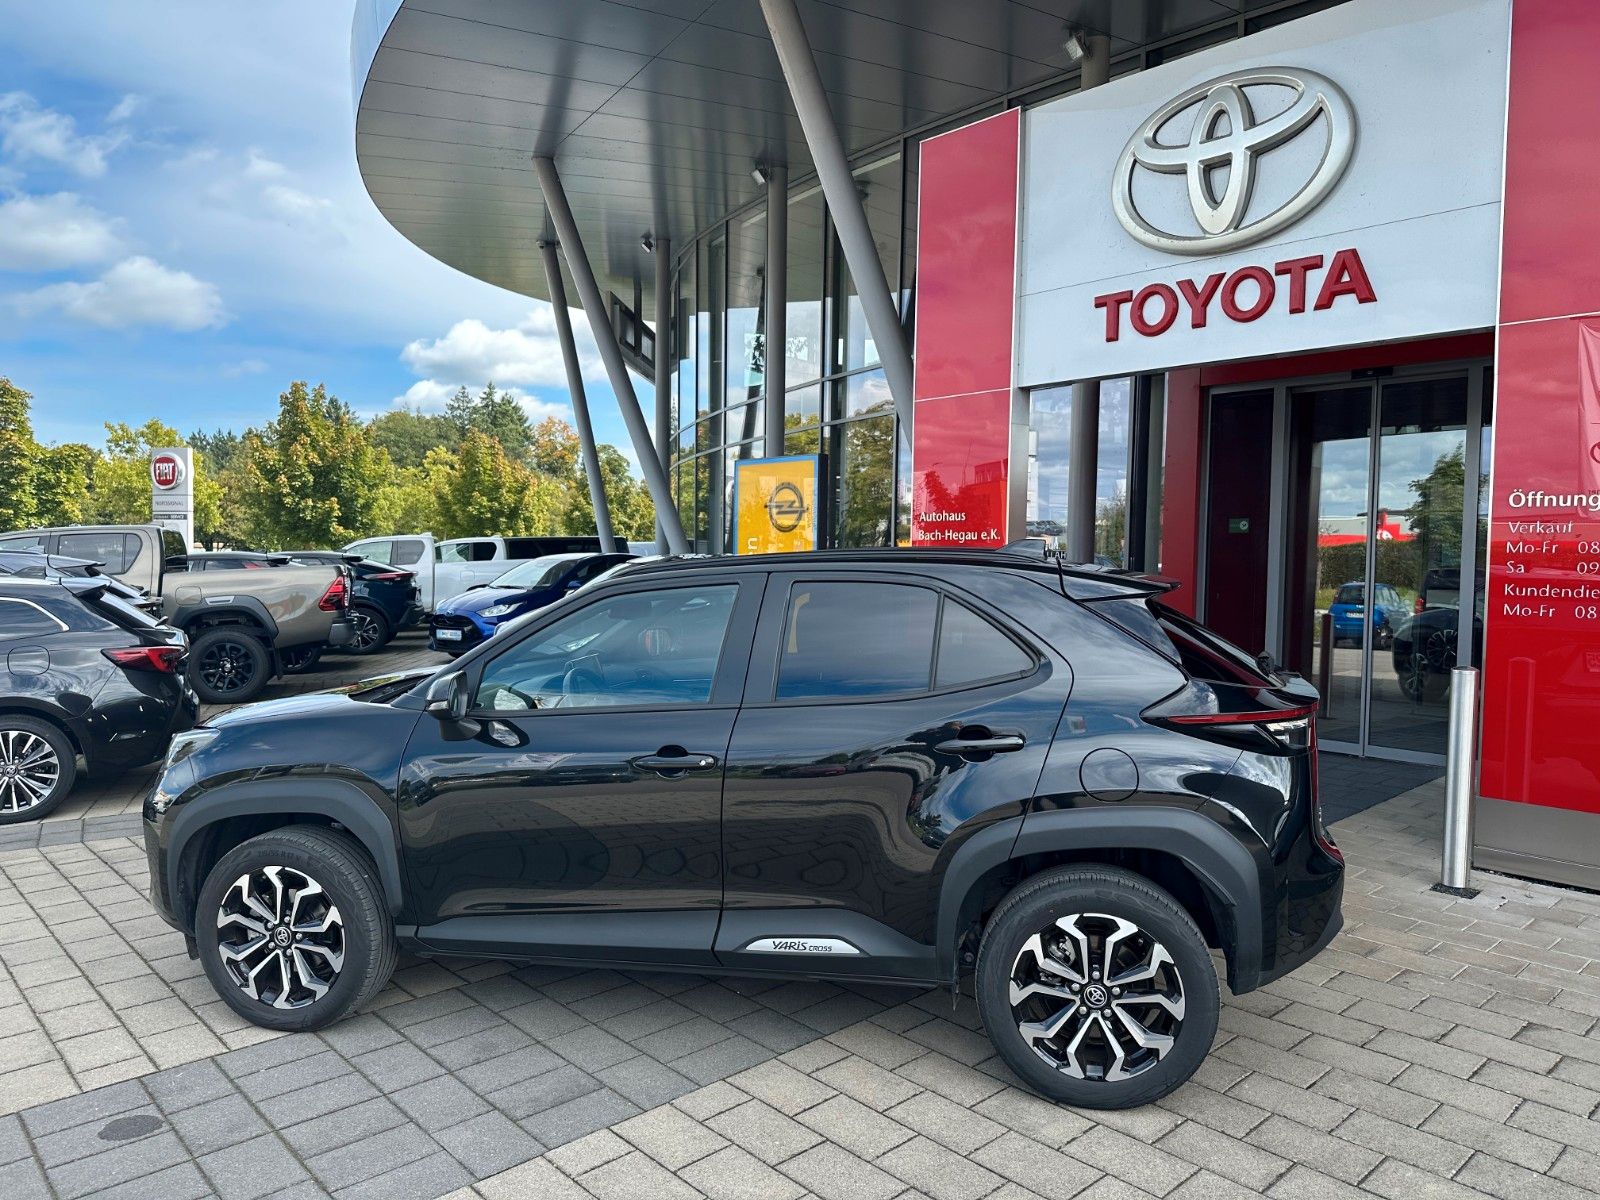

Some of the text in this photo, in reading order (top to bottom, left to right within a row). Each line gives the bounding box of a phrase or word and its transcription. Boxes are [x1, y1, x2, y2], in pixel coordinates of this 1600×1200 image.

[1094, 247, 1377, 342] TOYOTA
[155, 463, 174, 480] FIAT
[919, 510, 966, 522] Autohaus
[1508, 521, 1575, 534] Verkauf
[918, 529, 1001, 543] Bach-Hegau e.K.
[1506, 541, 1558, 554] Mo-Fr
[1506, 561, 1525, 574] Sa
[1504, 583, 1600, 599] Kundendie
[1503, 604, 1555, 617] Mo-Fr
